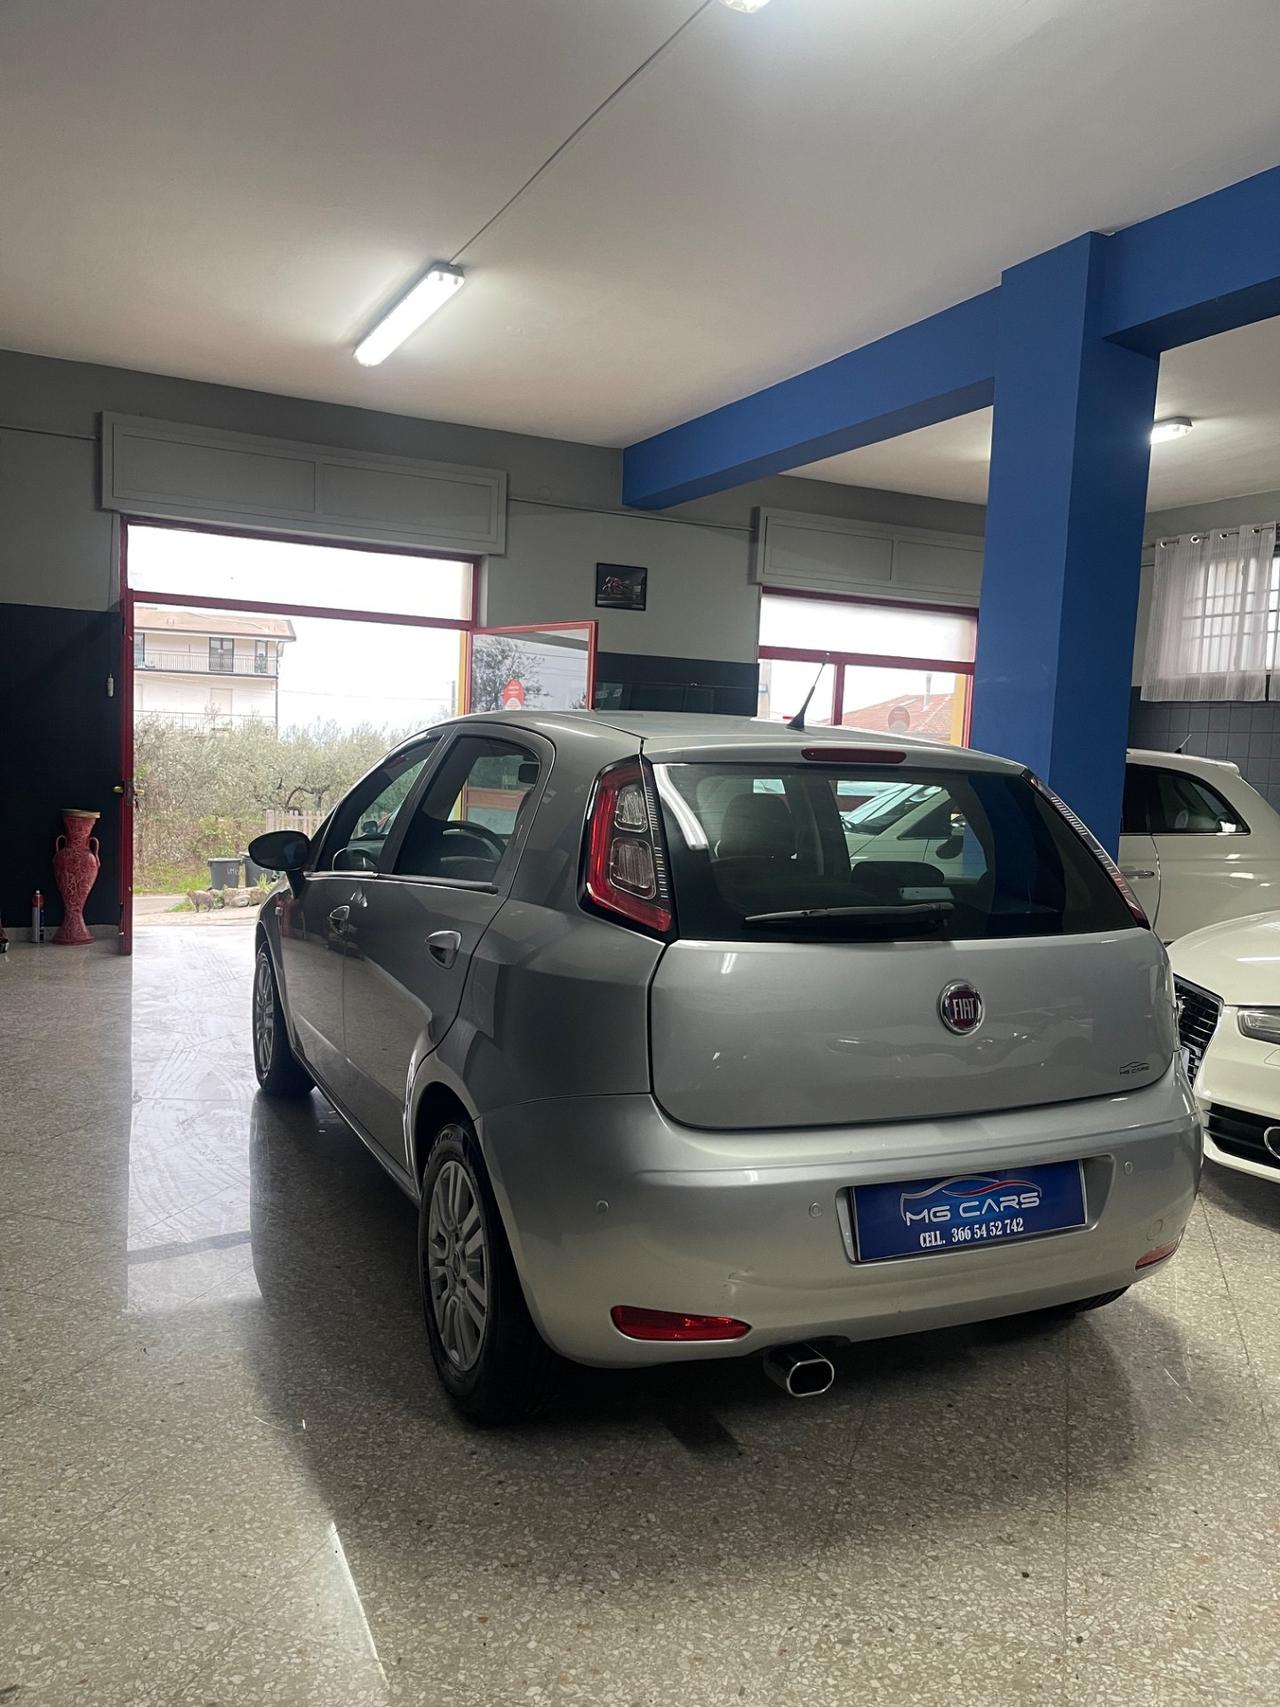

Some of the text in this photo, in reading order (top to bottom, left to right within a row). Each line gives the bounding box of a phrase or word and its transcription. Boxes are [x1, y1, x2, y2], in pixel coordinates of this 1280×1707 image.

[952, 997, 975, 1020] FIAT
[905, 1192, 1040, 1226] MG CARS
[919, 1217, 1024, 1248] CELL. 366 54 52 742
